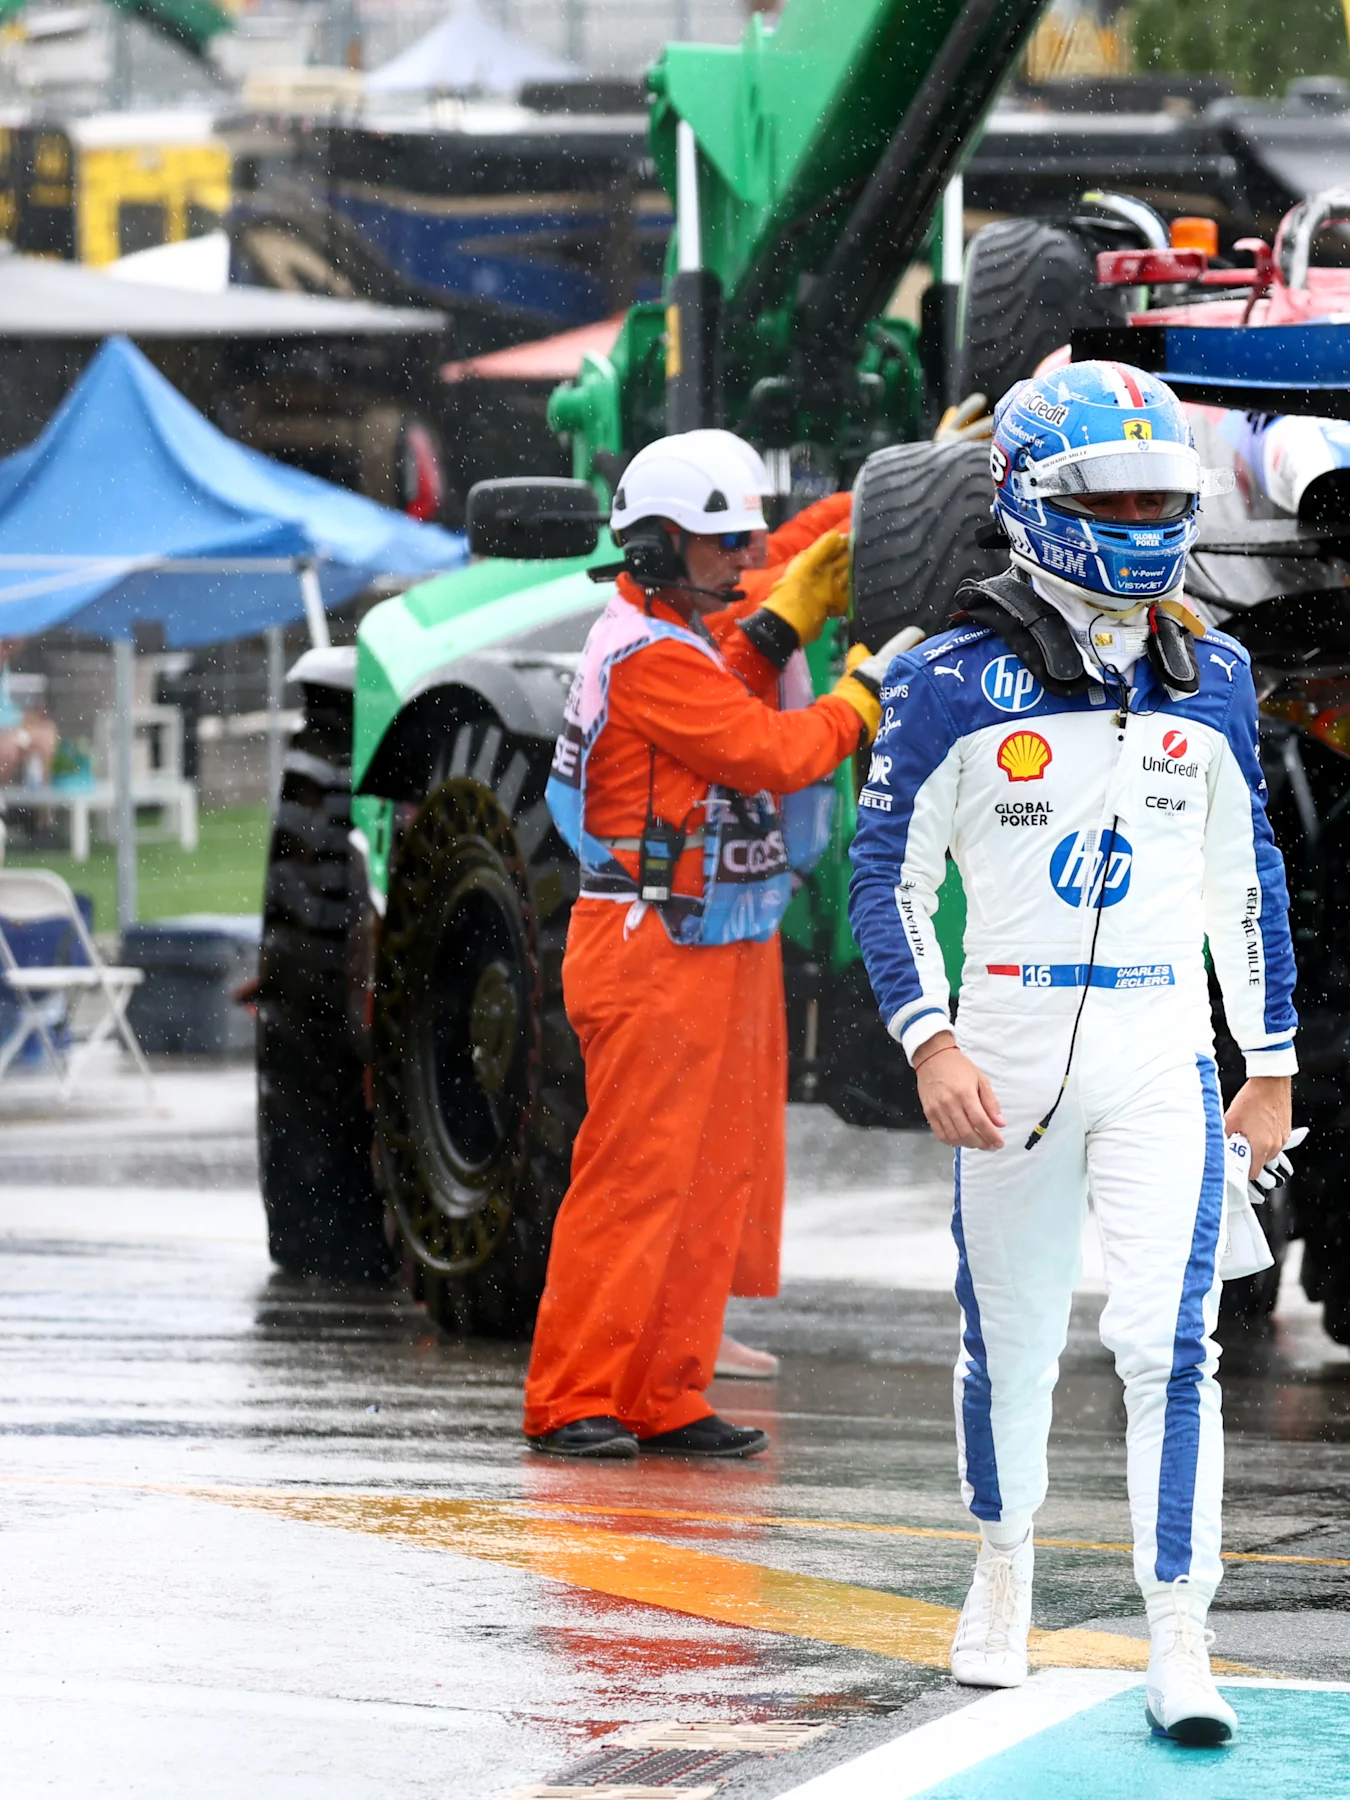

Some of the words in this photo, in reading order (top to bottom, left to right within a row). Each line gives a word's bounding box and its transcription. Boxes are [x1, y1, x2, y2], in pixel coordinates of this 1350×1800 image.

[1133, 533, 1161, 541] GLOBAL
[1042, 540, 1087, 577] IBM
[1132, 569, 1165, 578] V-Power
[992, 656, 1035, 711] hp
[1143, 755, 1198, 778] UniCredit
[995, 801, 1053, 814] GLOBAL
[1000, 814, 1048, 827] POKER
[1055, 828, 1132, 908] hp
[1247, 941, 1260, 986] MILLE
[1025, 965, 1051, 987] 16
[1117, 965, 1170, 978] CHARLES
[1115, 975, 1170, 989] LECLERC
[1229, 1142, 1247, 1158] 16
